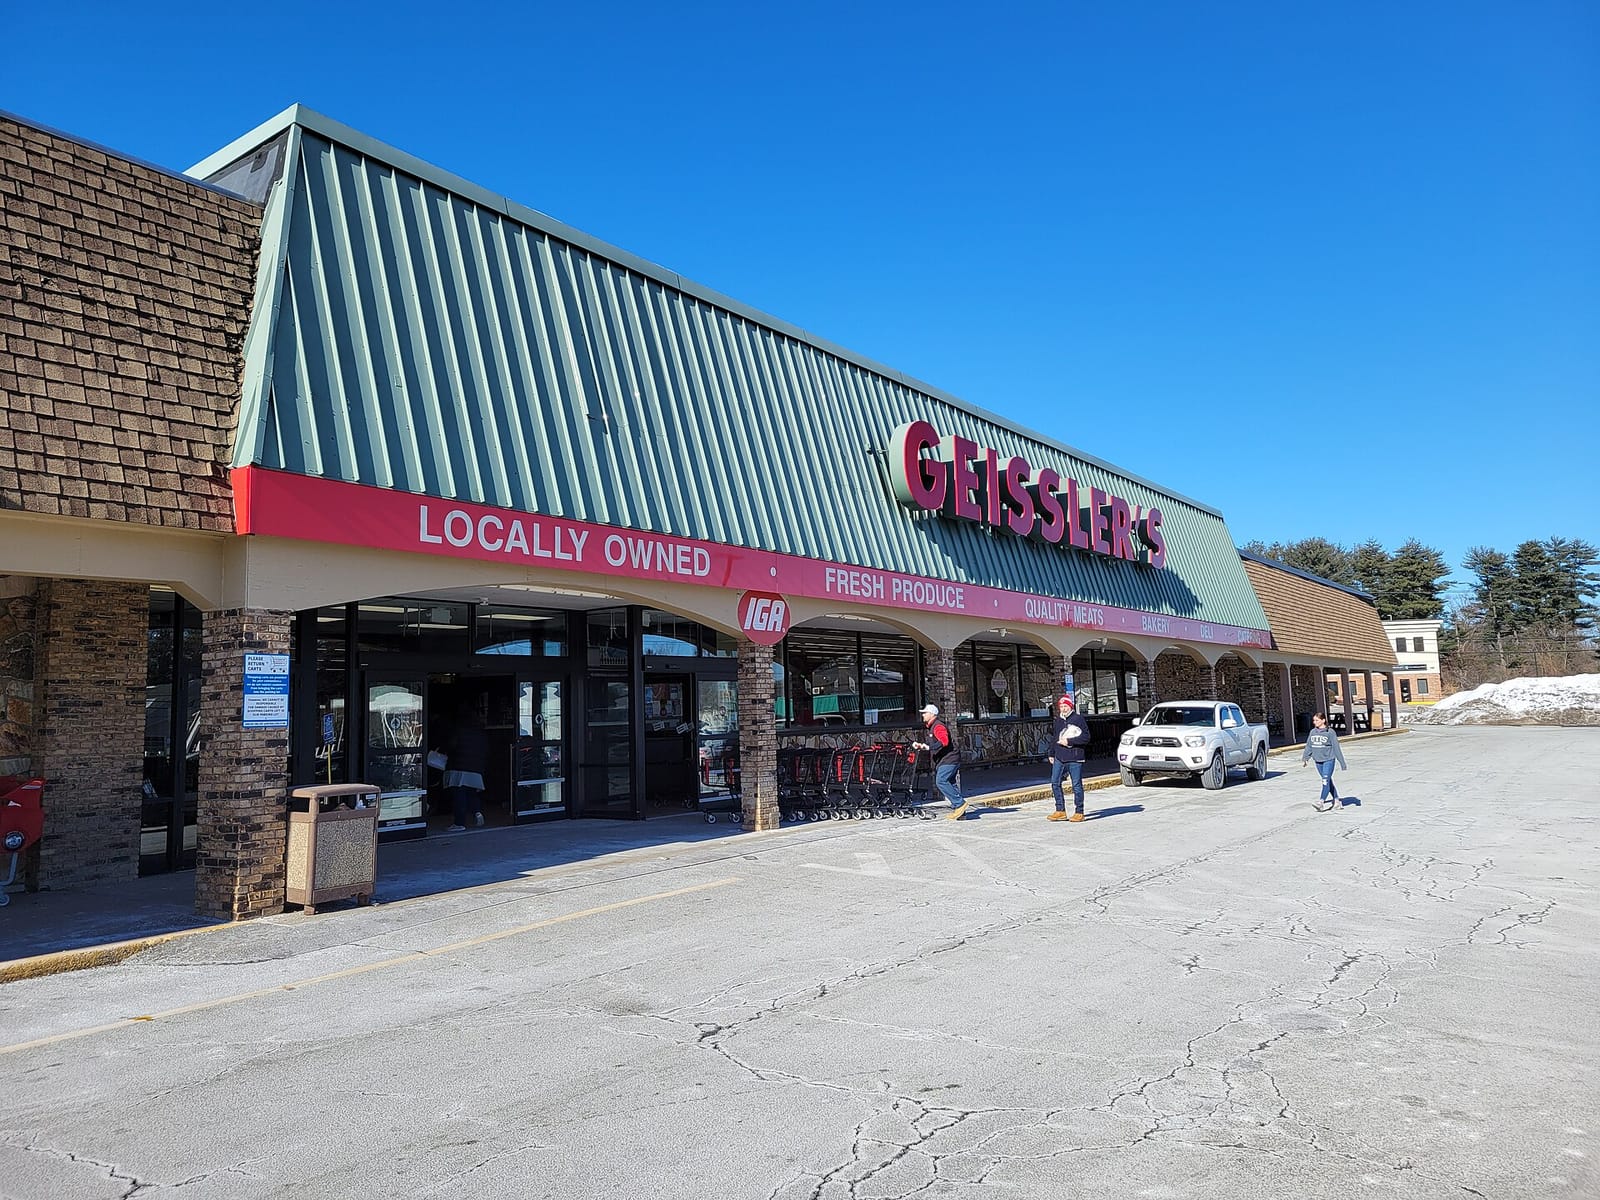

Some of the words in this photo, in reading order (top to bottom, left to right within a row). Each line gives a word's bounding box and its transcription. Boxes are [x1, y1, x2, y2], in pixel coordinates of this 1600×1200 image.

[903, 420, 1166, 569] GEISSLER'S
[419, 505, 588, 562] LOCALLY
[604, 534, 711, 577] OWNED
[825, 567, 884, 599] FRESH
[892, 578, 965, 609] PRODUCE
[743, 597, 786, 633] IGA
[1025, 599, 1070, 621] QUALITY
[1073, 605, 1104, 626] MEATS
[1142, 617, 1170, 634] BAKERY
[1200, 624, 1214, 639] DELI
